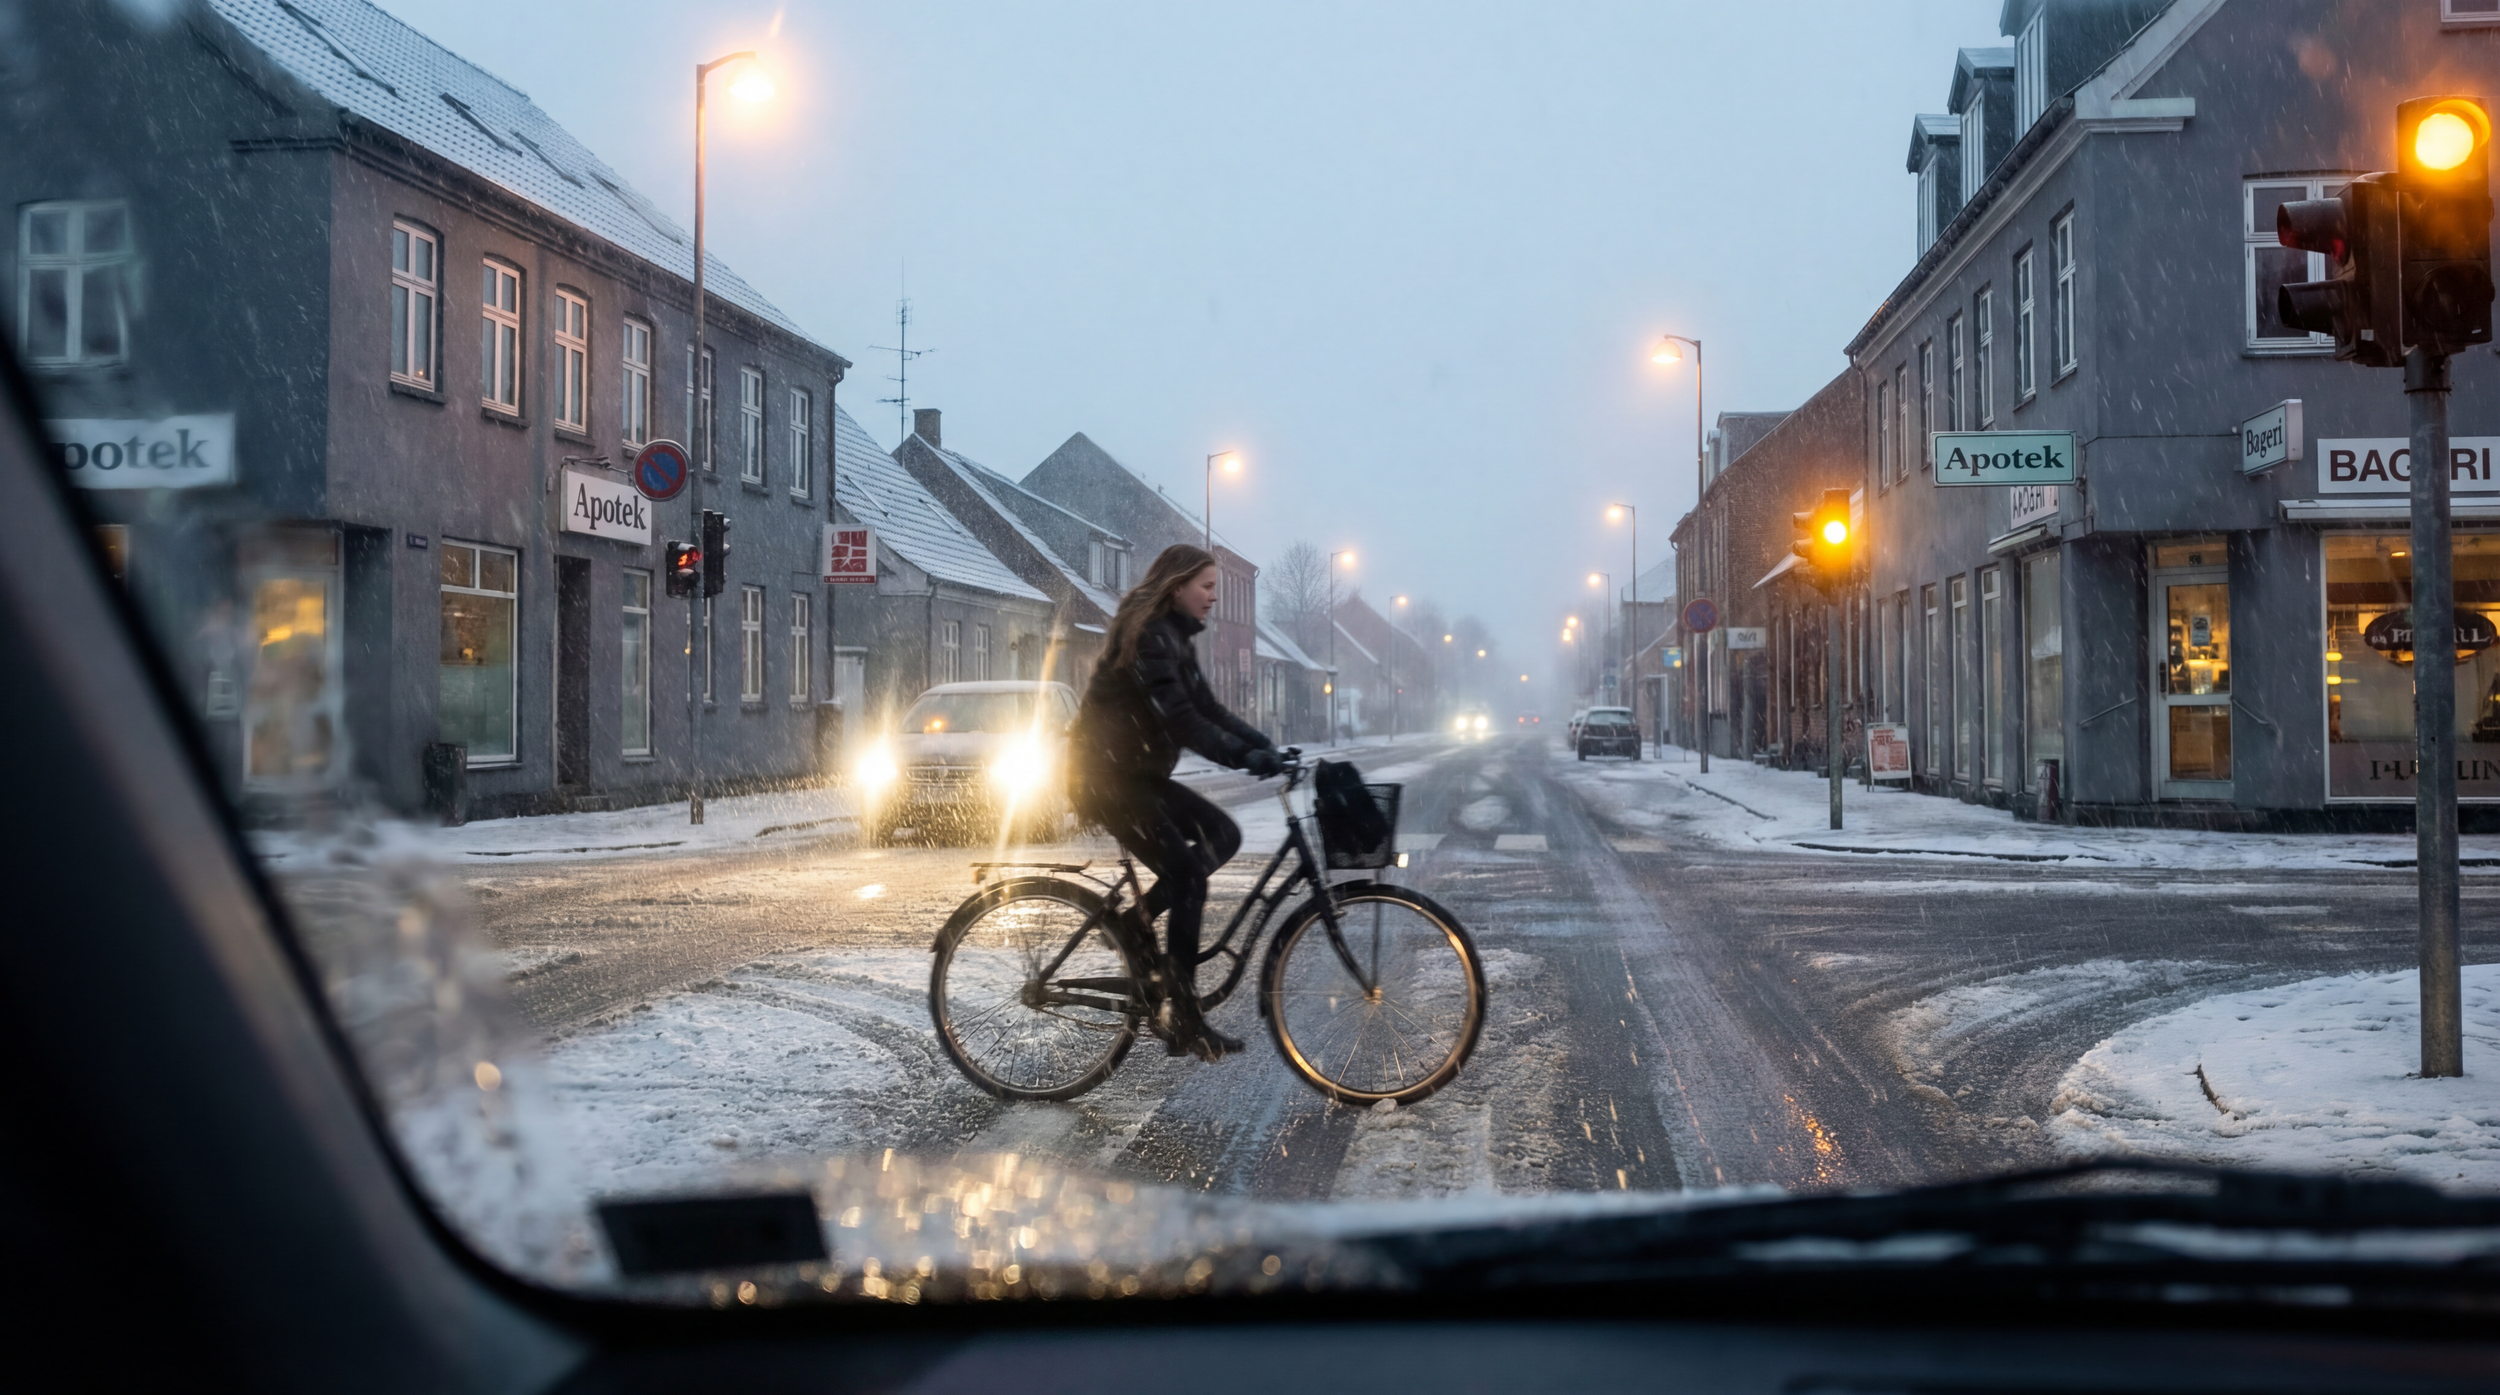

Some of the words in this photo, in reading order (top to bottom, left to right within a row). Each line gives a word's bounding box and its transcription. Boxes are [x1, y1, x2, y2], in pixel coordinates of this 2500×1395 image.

[50, 428, 211, 471] potek
[2246, 417, 2283, 458] Bageri
[1944, 445, 2065, 477] Apotek
[2329, 447, 2491, 482] BAGRI
[573, 482, 647, 530] Apotek
